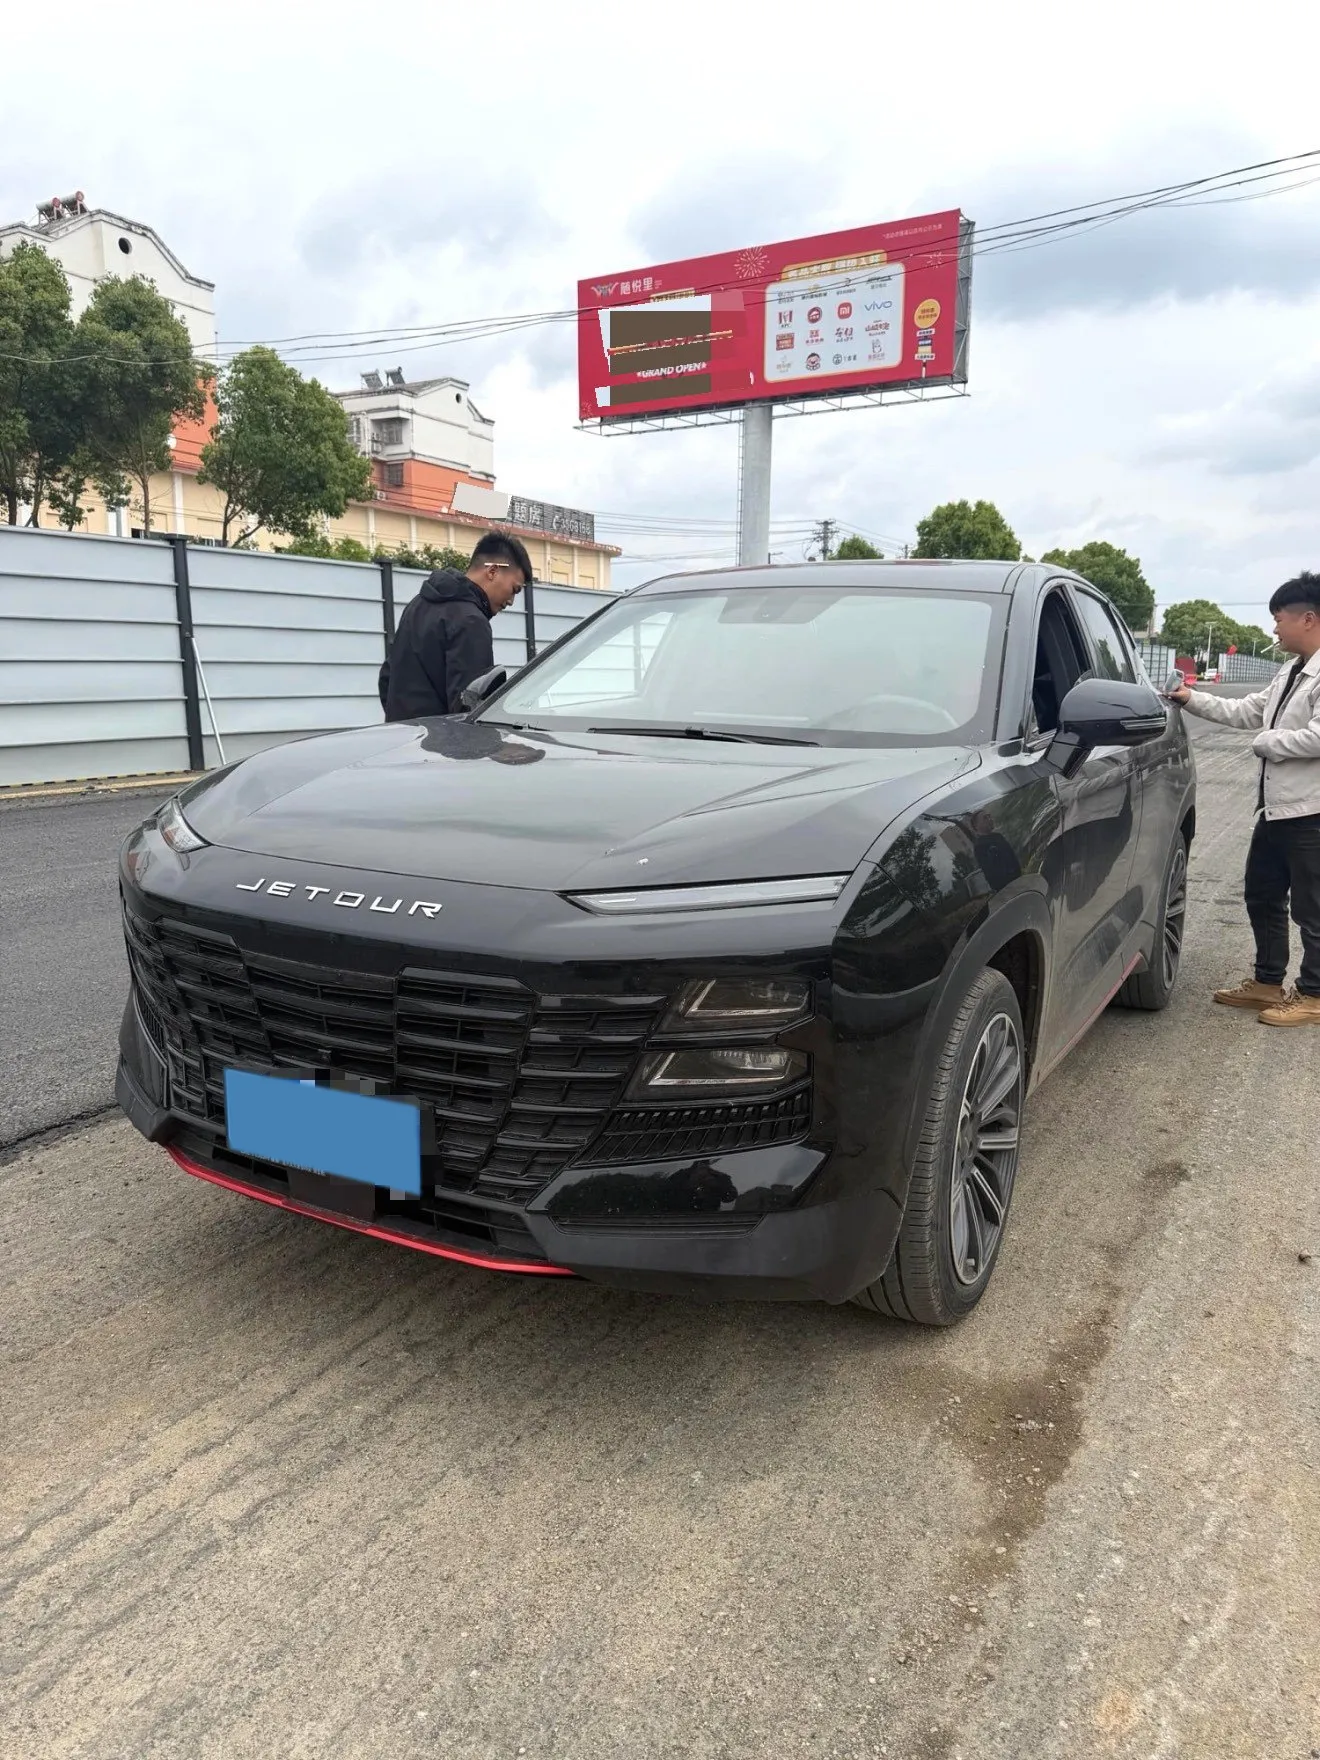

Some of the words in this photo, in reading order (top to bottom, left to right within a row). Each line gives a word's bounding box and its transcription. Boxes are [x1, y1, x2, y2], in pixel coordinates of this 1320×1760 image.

[865, 301, 893, 312] vivo
[642, 366, 674, 378] GRAND
[675, 361, 702, 373] OPEN
[236, 878, 443, 918] JETOUR
